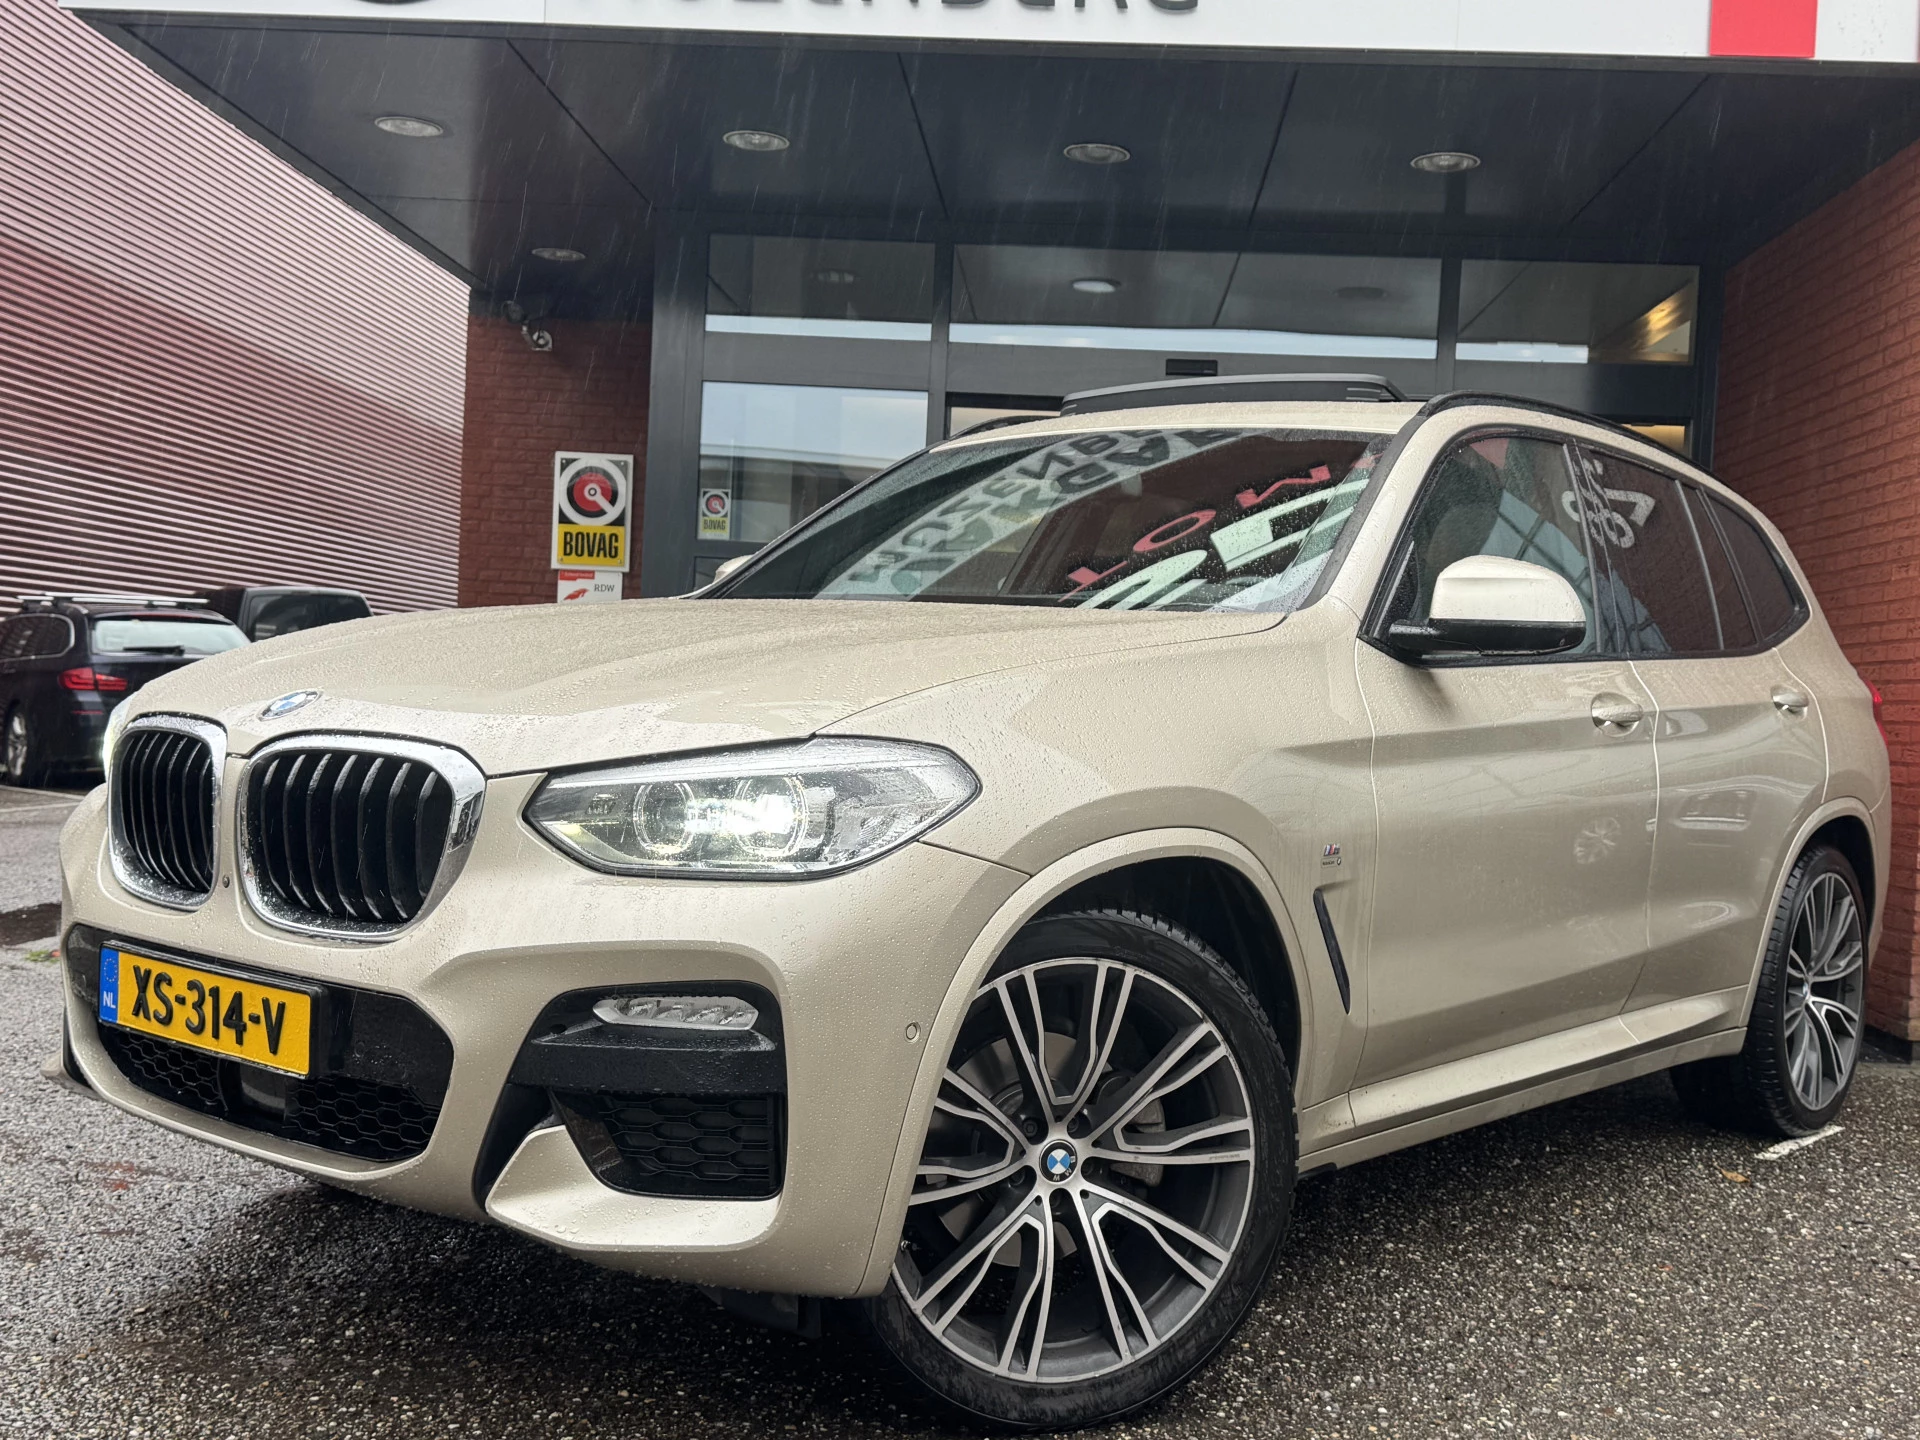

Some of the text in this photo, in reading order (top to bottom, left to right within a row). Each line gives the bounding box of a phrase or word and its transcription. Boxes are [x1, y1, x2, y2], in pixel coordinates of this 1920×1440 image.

[703, 518, 726, 530] BOVAG
[563, 531, 619, 559] BOVAG
[594, 583, 615, 592] RDW
[103, 991, 116, 1009] NL
[131, 964, 286, 1055] XS-314-V
